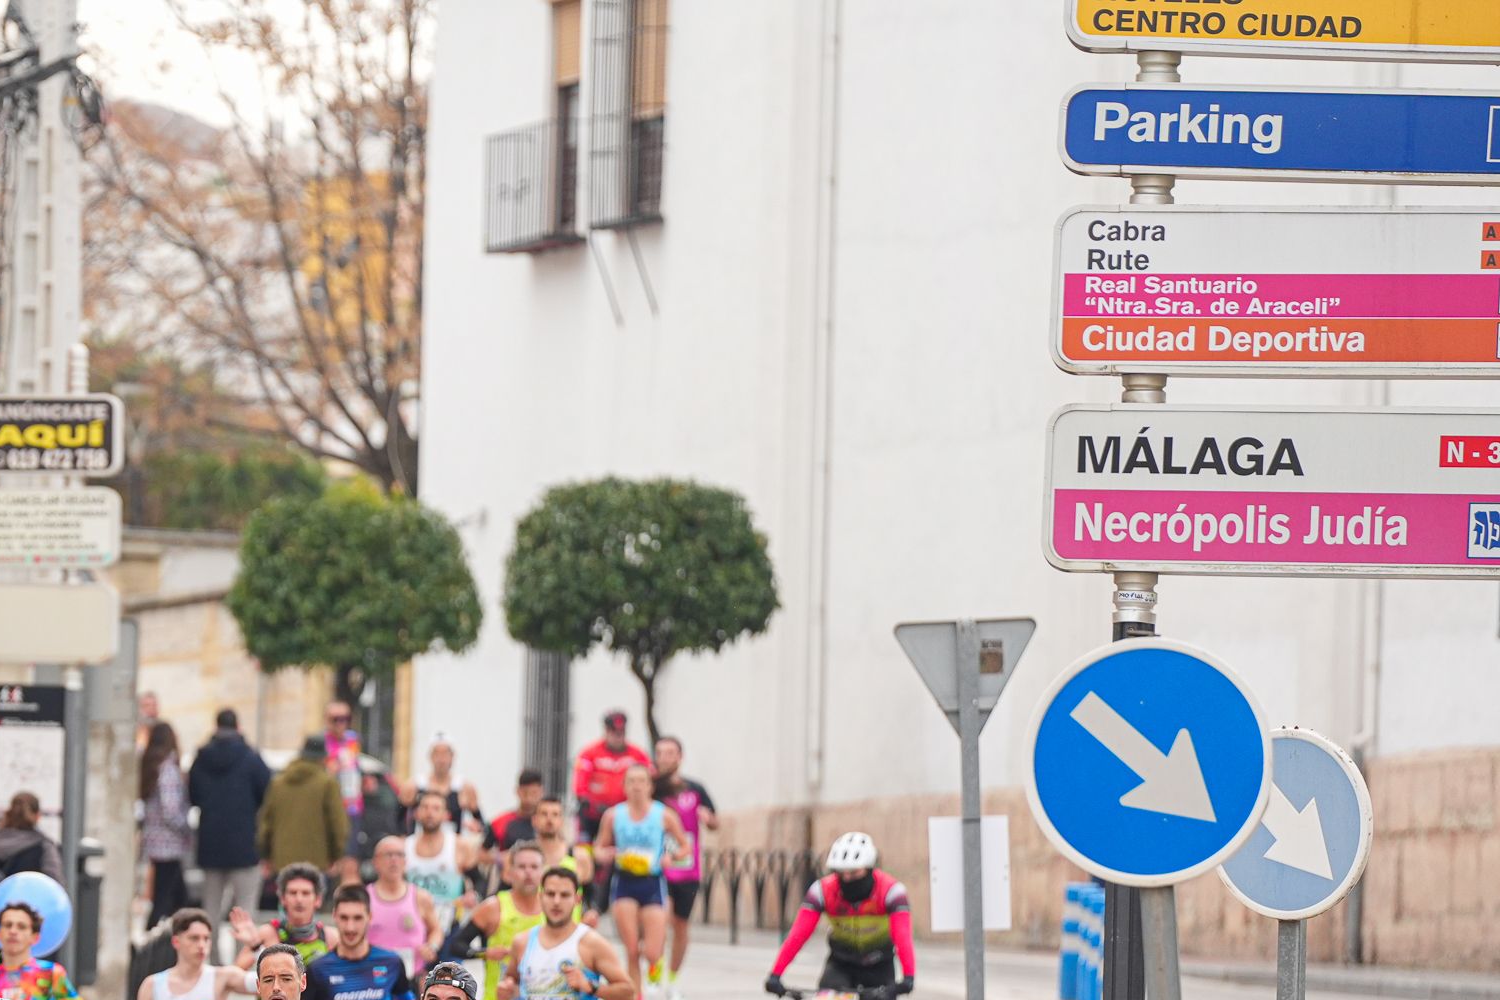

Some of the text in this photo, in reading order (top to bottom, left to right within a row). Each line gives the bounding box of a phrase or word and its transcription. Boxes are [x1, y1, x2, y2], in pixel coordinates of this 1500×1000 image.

[1093, 9, 1362, 38] CENTRO CIUDAD
[1093, 102, 1283, 154] Parking
[1087, 220, 1166, 242] Cabra
[1087, 249, 1150, 271] Rute
[1085, 276, 1258, 294] Real Santuario
[1210, 298, 1240, 315] de
[1082, 325, 1365, 358] Ciudad Deportiva
[1077, 426, 1305, 477] MÁLAGA
[1074, 502, 1408, 552] Necrópolis Judía
